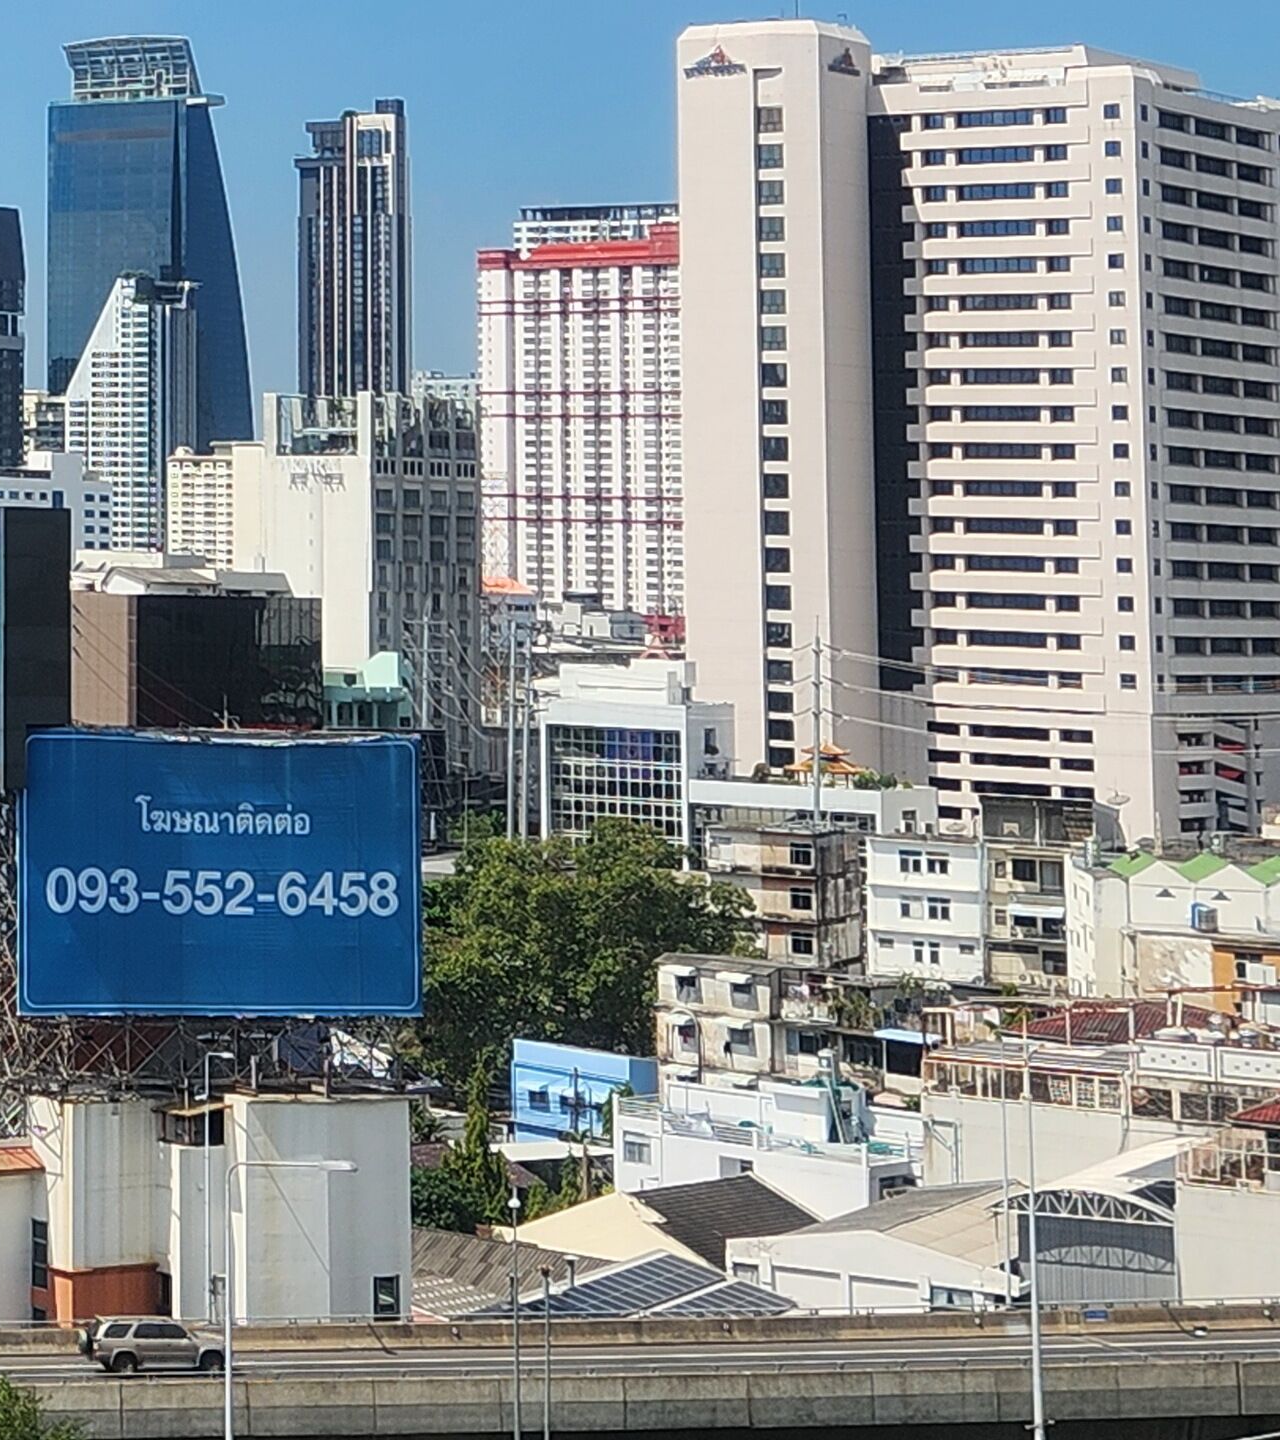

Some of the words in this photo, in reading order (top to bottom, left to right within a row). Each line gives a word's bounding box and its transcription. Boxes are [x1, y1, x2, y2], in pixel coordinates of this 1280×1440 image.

[135, 794, 311, 835] โฆษณาติดต่อ
[45, 866, 399, 918] 093-552-6458
